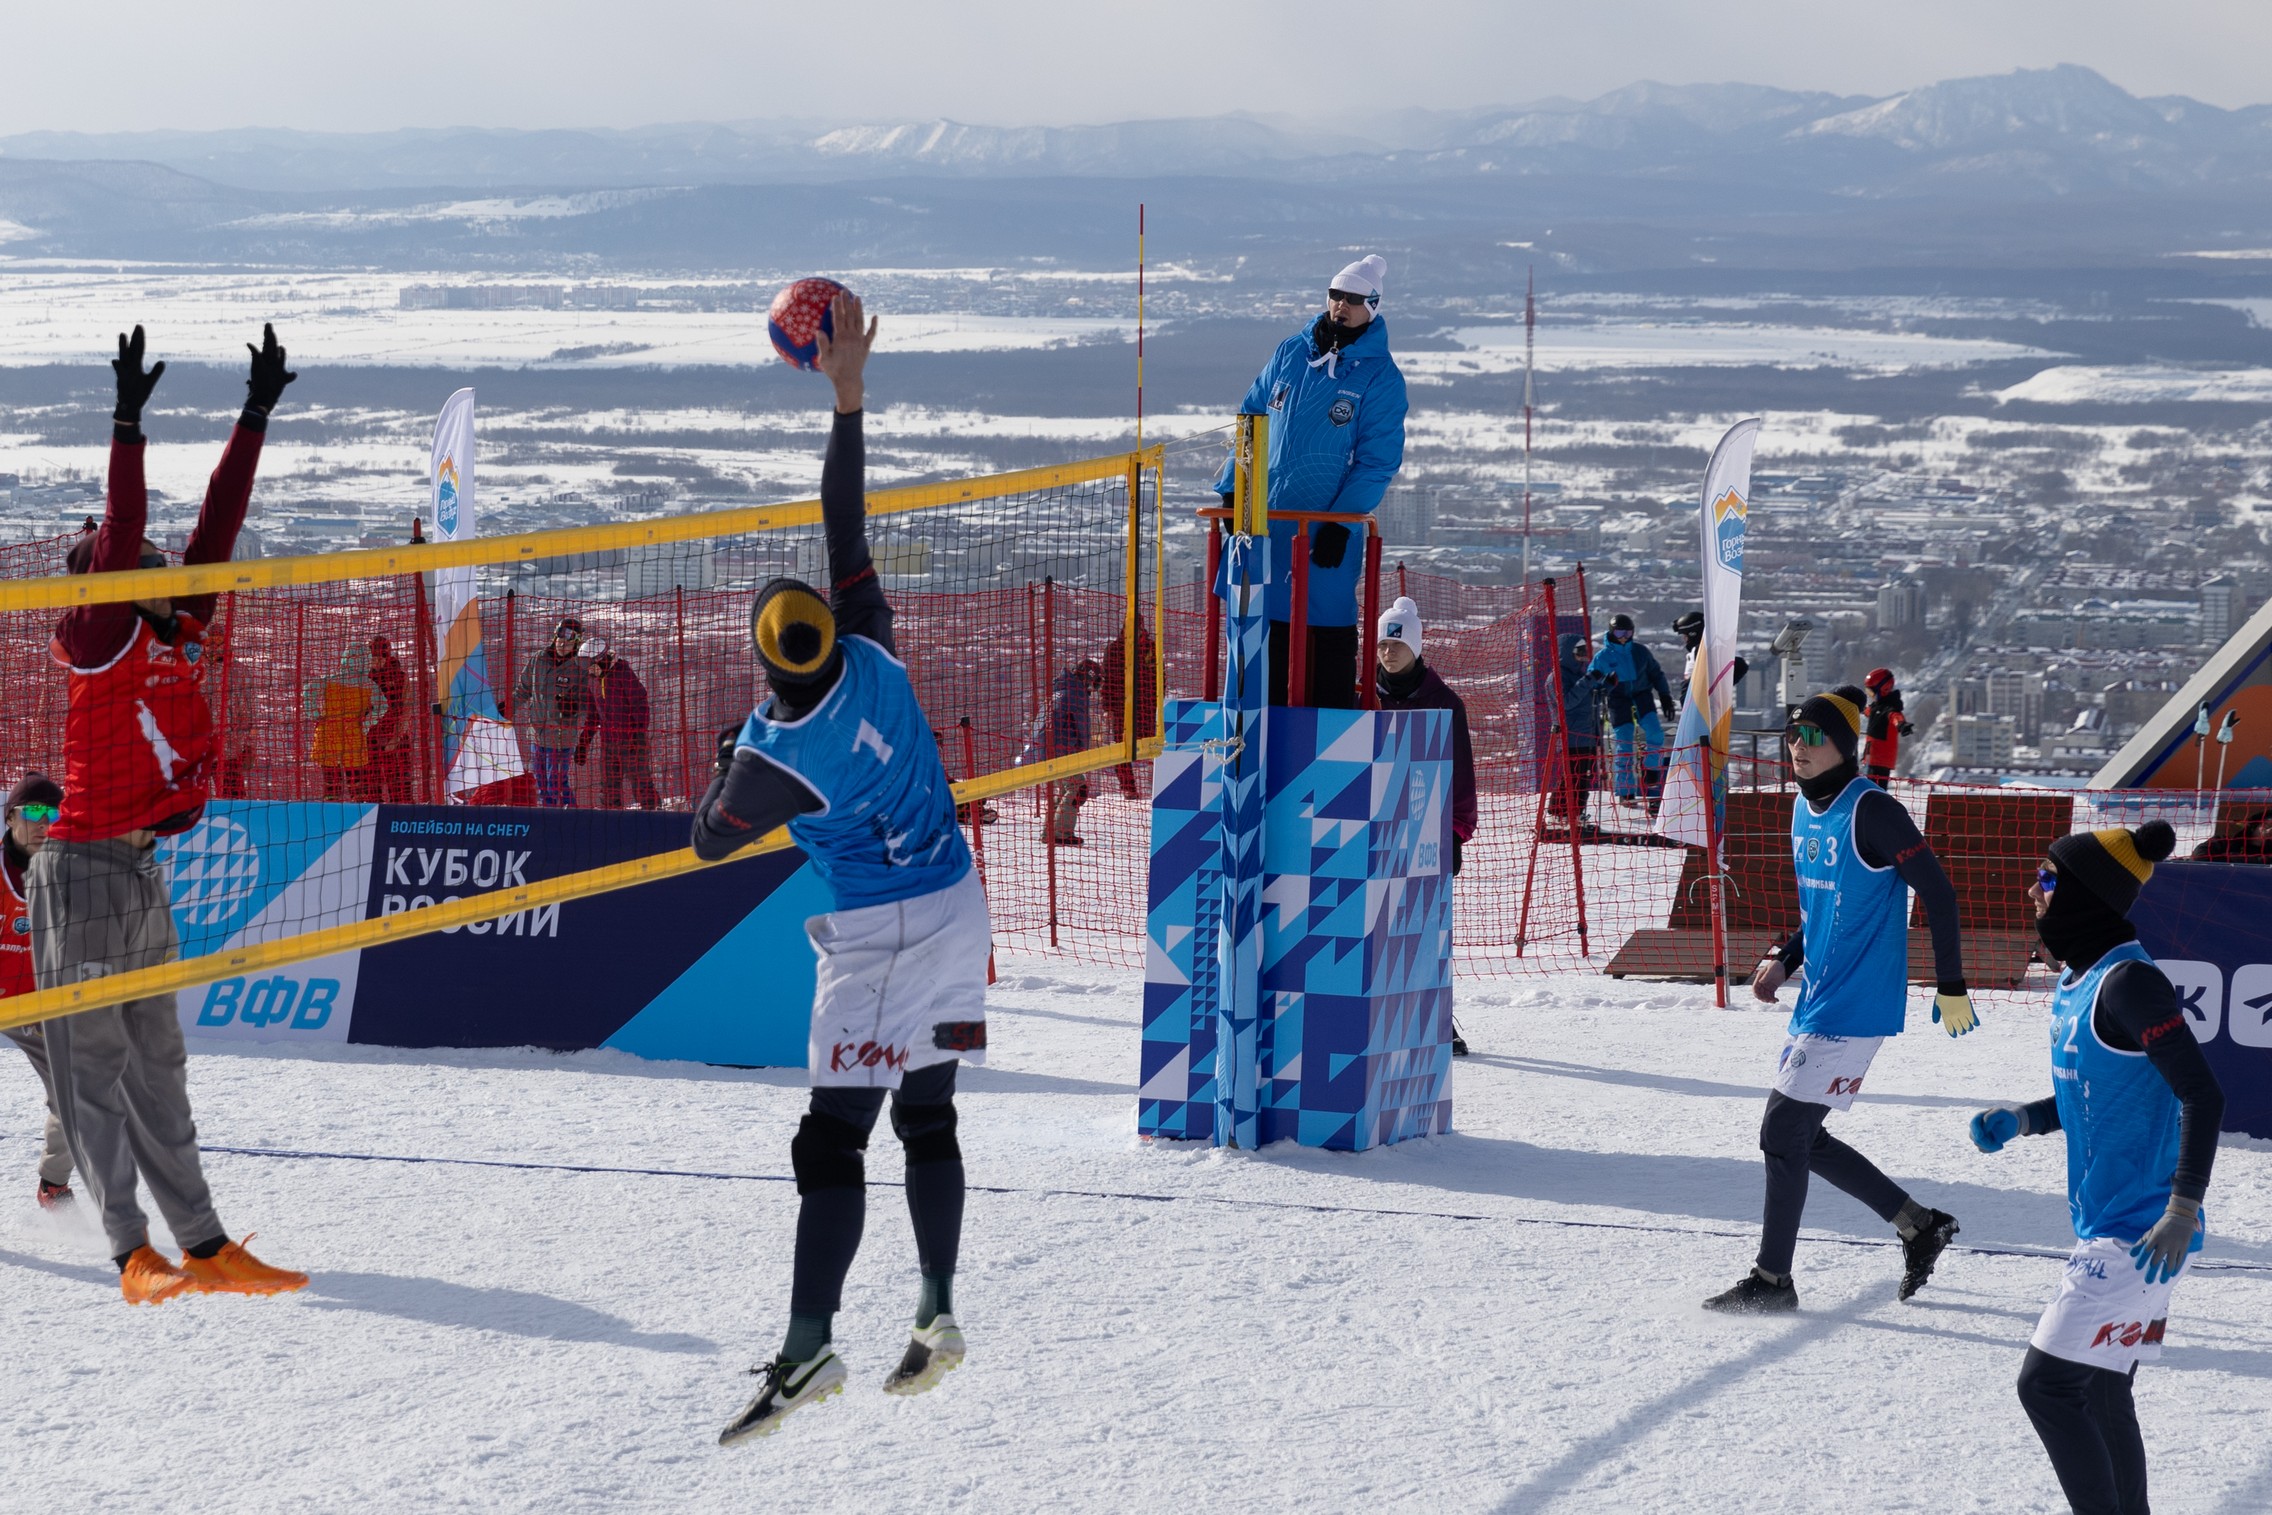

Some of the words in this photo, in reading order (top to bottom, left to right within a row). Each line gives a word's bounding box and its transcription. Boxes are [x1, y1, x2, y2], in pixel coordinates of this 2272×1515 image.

[390, 819, 462, 836] ВОЛЕЙБОЛ
[464, 823, 484, 836] НА
[486, 823, 531, 837] СНЕГУ
[384, 846, 533, 889] КУБОК
[1417, 841, 1438, 869] ВФВ
[1823, 835, 1838, 867] 3
[196, 974, 341, 1030] ВФВ
[2062, 1015, 2079, 1054] 2
